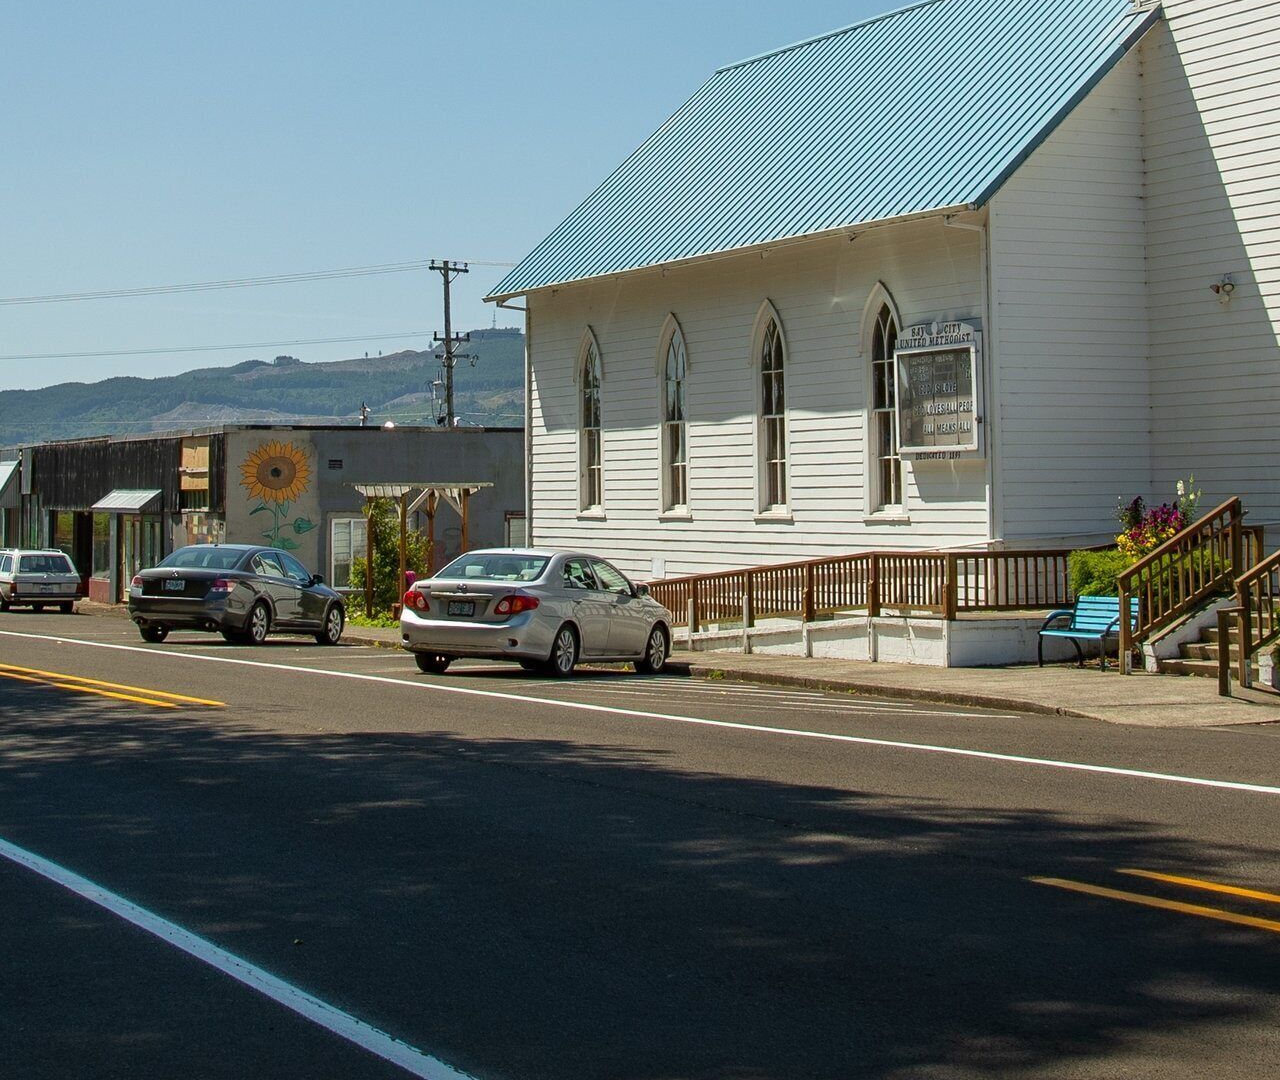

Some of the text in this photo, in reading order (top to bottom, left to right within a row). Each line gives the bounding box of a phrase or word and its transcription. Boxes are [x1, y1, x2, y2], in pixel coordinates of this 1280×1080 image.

[912, 323, 962, 338] BAY CITY
[900, 332, 971, 349] UNITED METHODIST
[926, 403, 945, 415] LOVES
[946, 402, 957, 413] ALL
[923, 421, 970, 434] ALL MEANS ALL
[915, 451, 946, 460] DEDICATED
